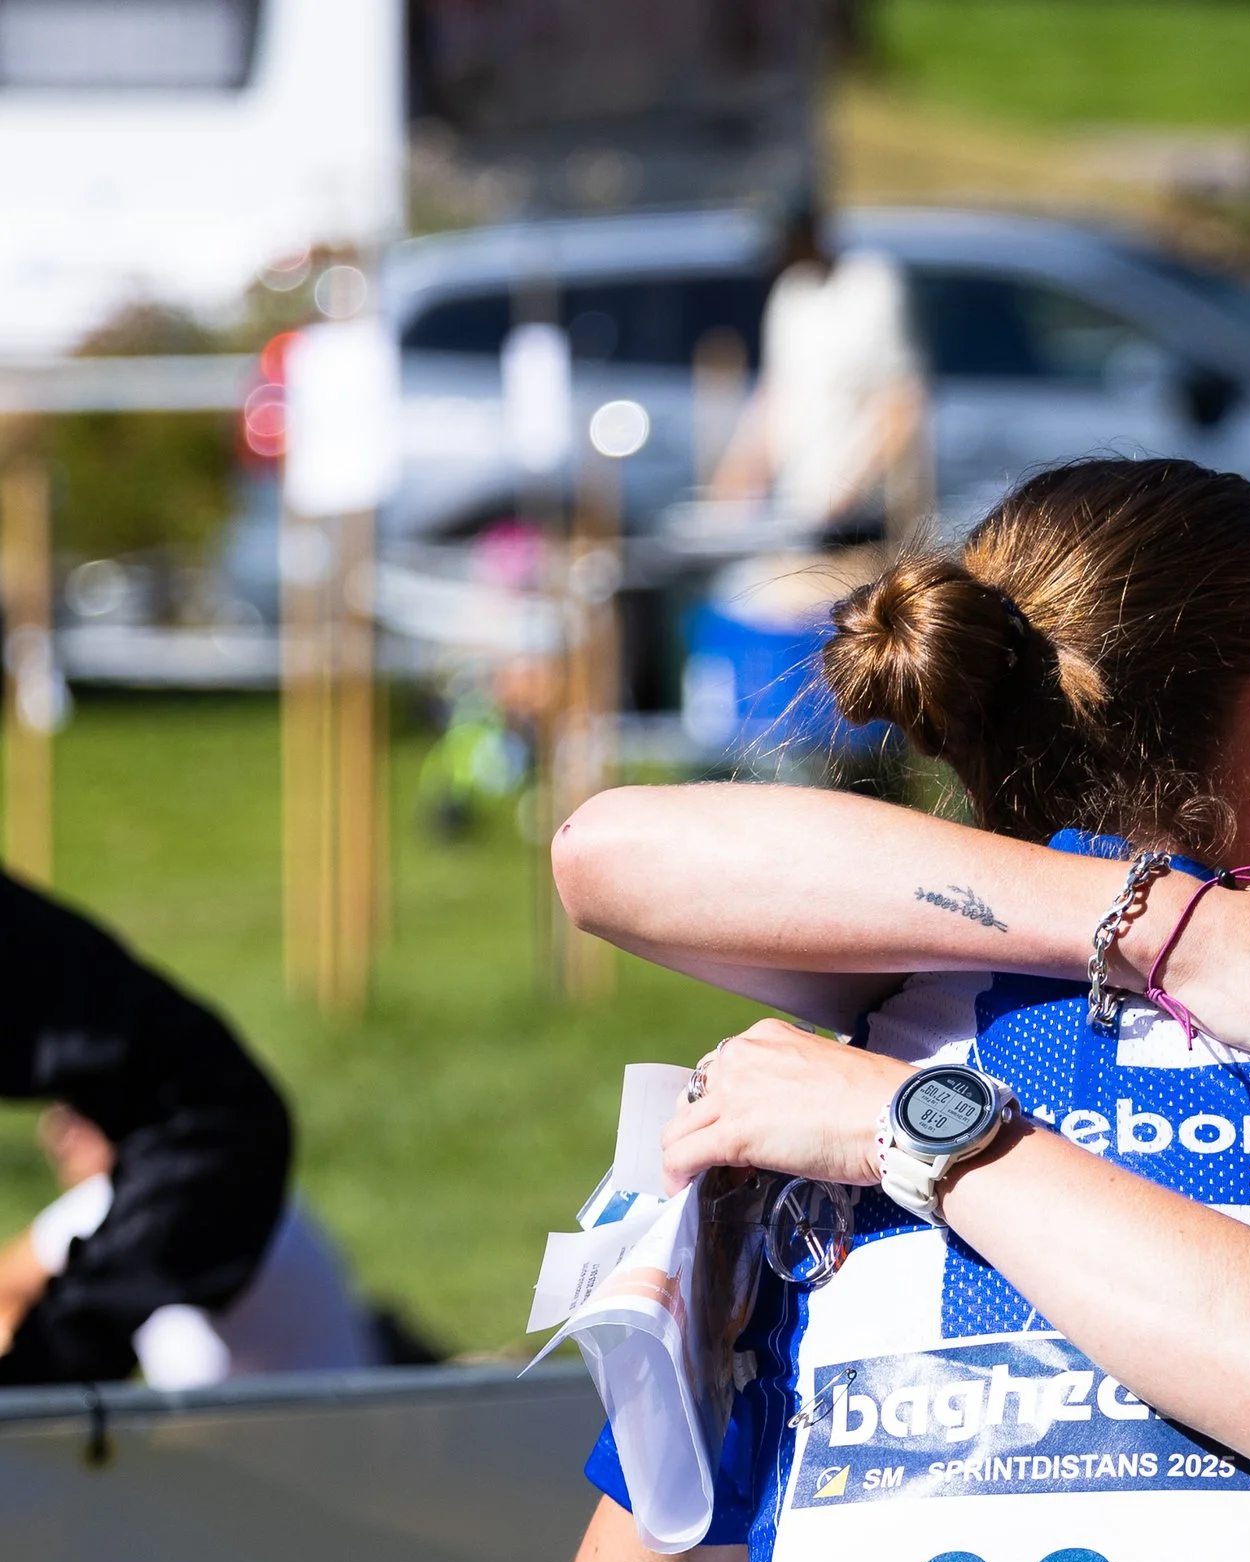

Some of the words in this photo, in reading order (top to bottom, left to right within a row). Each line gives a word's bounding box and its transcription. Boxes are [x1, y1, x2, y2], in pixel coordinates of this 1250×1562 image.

[953, 1082, 968, 1094] 177
[921, 1109, 947, 1128] 0:18
[955, 1101, 975, 1117] 0.01
[828, 1364, 1161, 1447] baghee
[862, 1466, 904, 1490] SM
[927, 1454, 1158, 1482] SPRINTDISTANS
[1167, 1453, 1236, 1478] 2025
